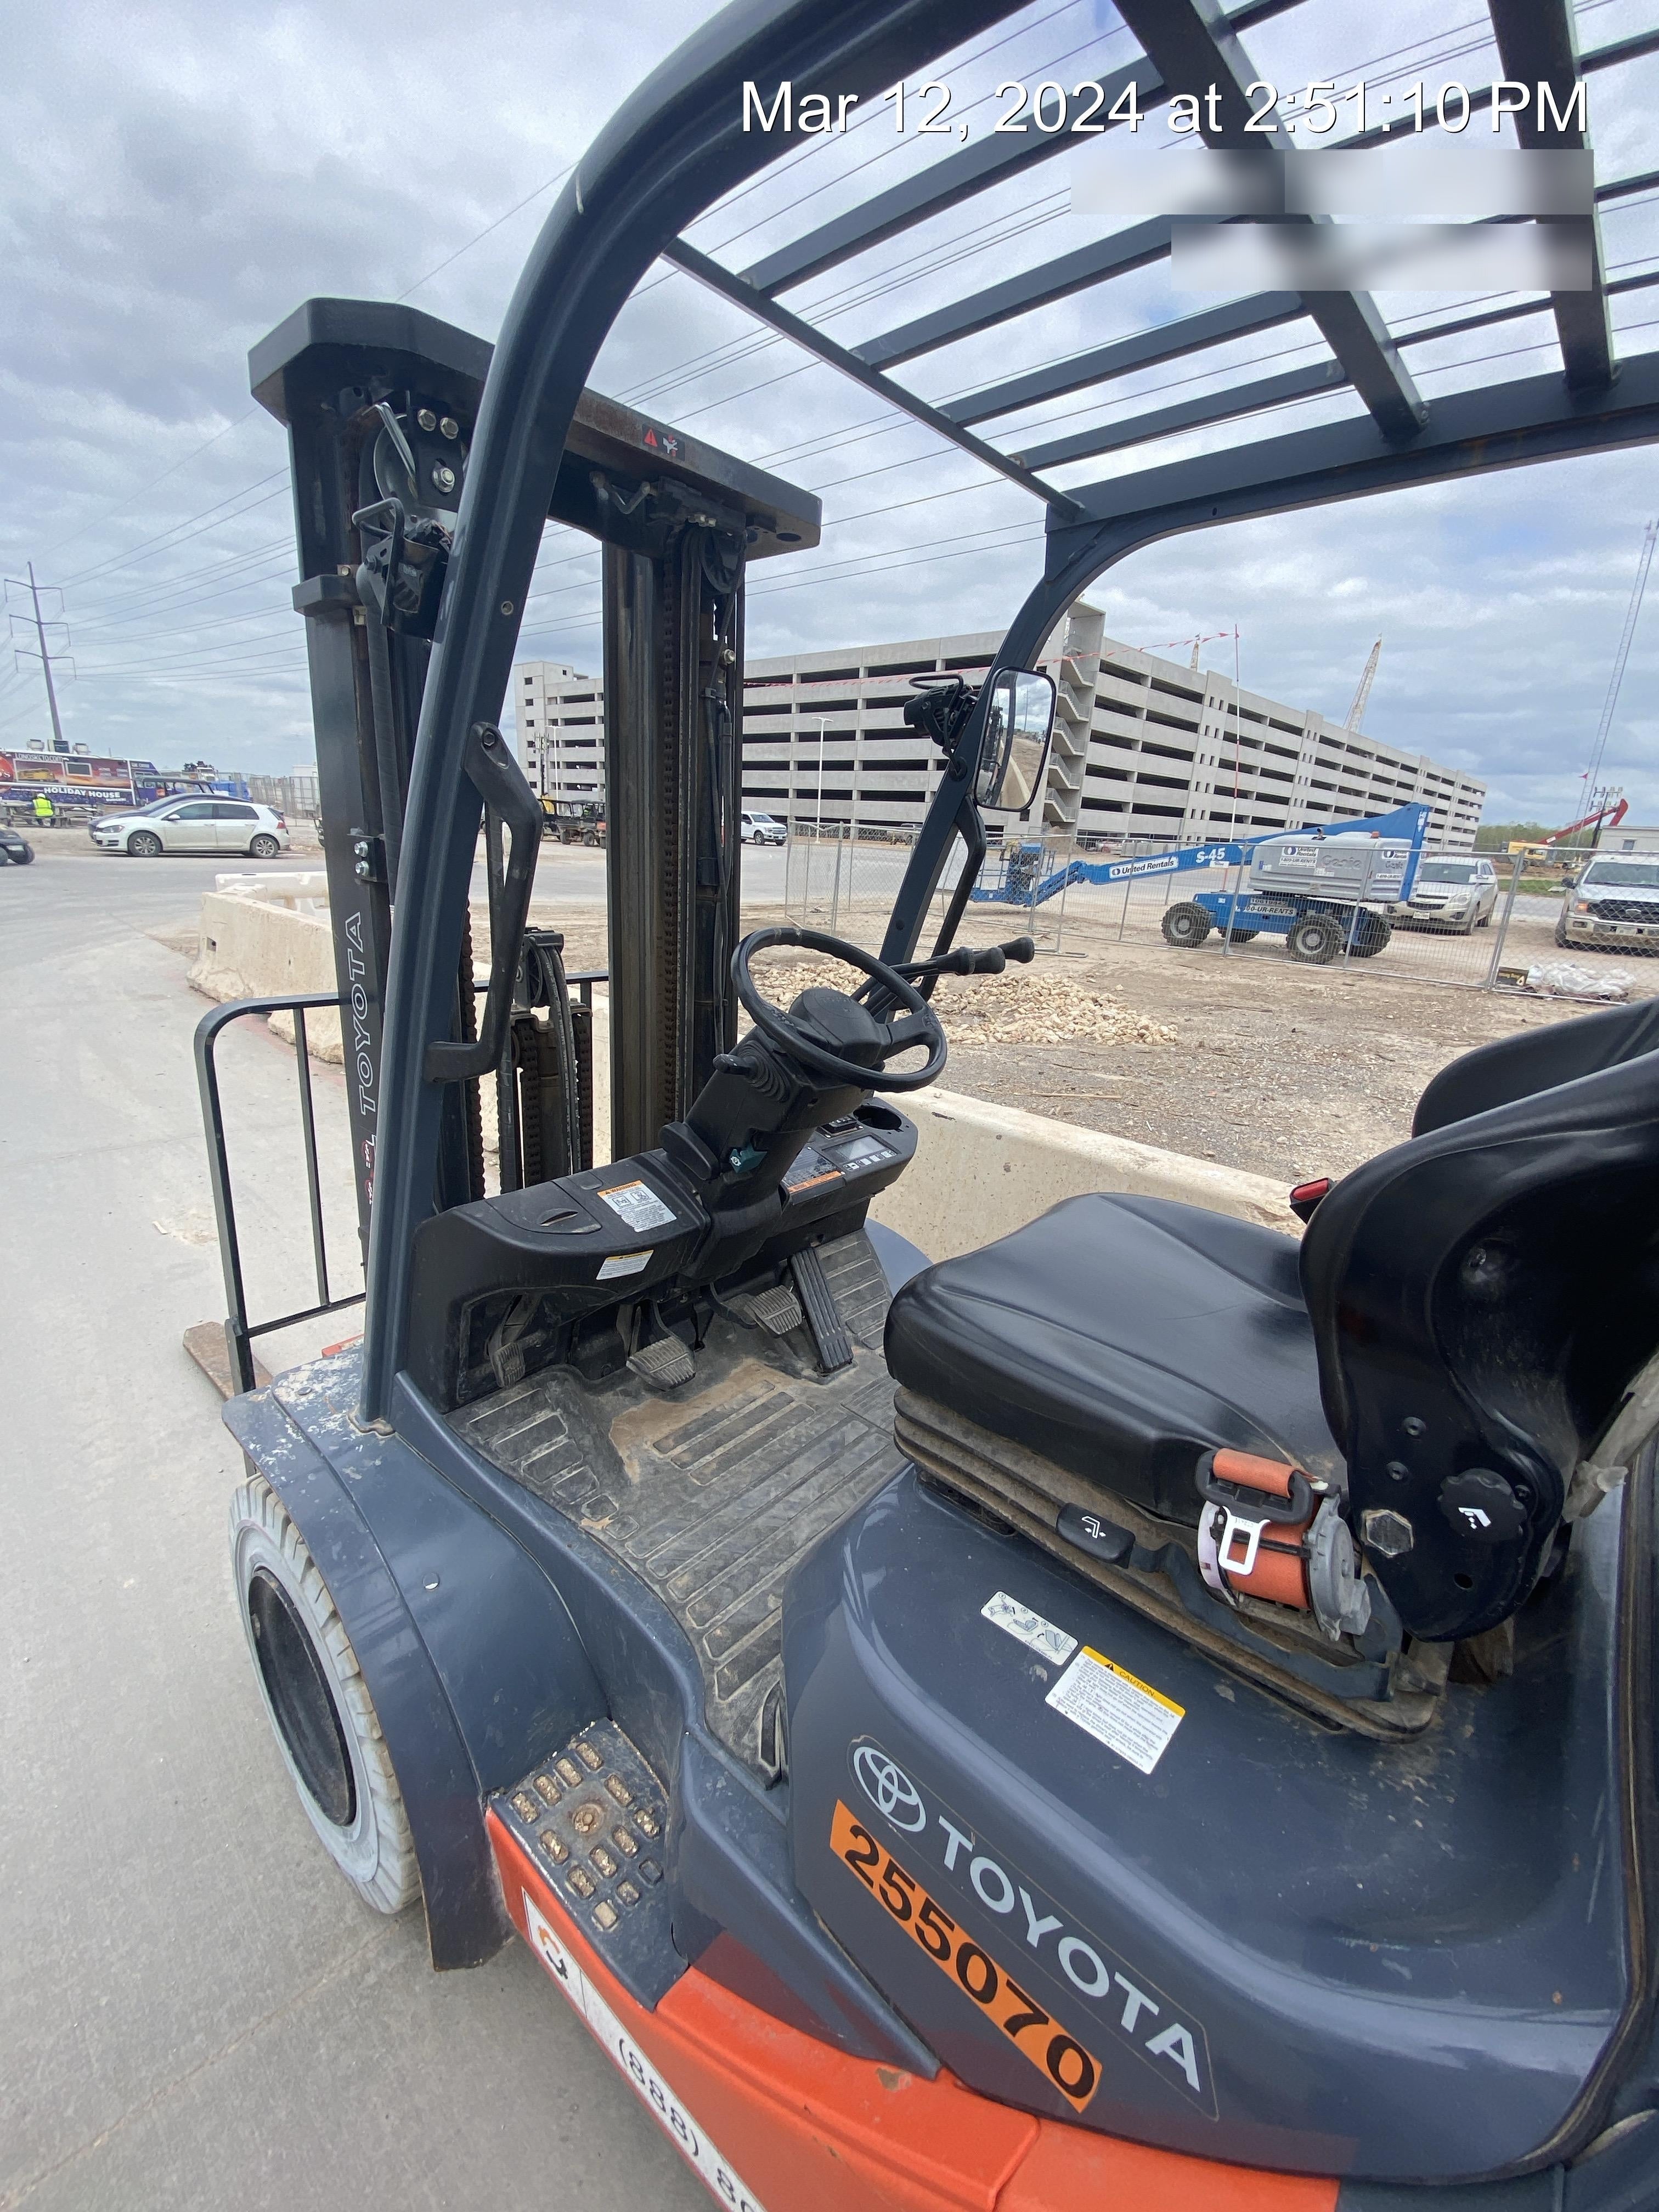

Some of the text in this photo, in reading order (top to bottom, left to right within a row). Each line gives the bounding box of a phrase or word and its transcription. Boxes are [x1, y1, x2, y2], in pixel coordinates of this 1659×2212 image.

[44, 787, 86, 796] HOLIDAY
[89, 791, 121, 799] HOUSE
[1147, 859, 1174, 871] Rentals
[1196, 848, 1225, 864] S-45
[345, 911, 376, 1116] TOYOTA
[1120, 1671, 1154, 1697] CAUTION
[844, 1825, 1095, 2099] 255070
[939, 1815, 1200, 2092] TOYOTA
[619, 2038, 699, 2157] (888)
